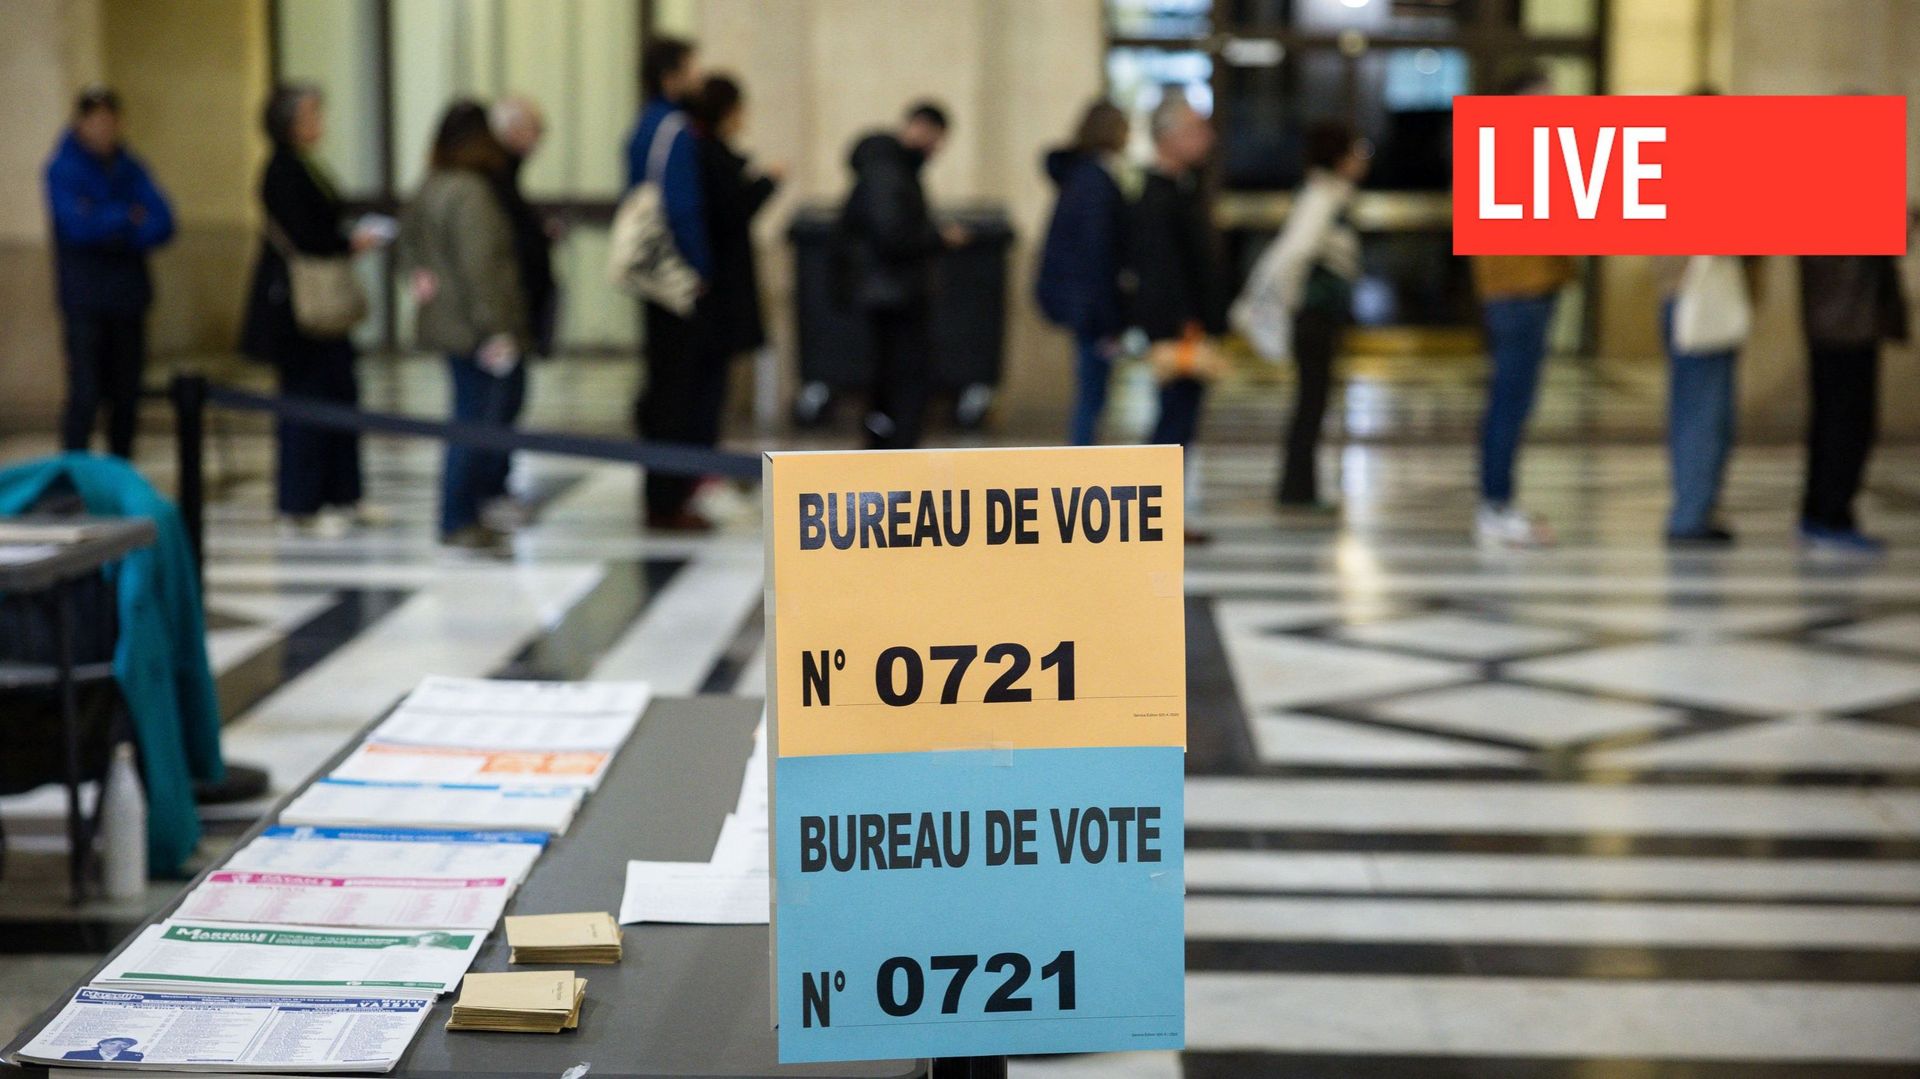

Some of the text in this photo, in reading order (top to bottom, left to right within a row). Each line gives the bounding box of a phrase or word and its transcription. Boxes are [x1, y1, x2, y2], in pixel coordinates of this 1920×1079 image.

[799, 486, 1162, 550] BUREAU DE VOTE
[876, 641, 1074, 706] 0721
[801, 807, 1161, 872] BUREAU DE VOTE
[877, 951, 1075, 1017] 0721
